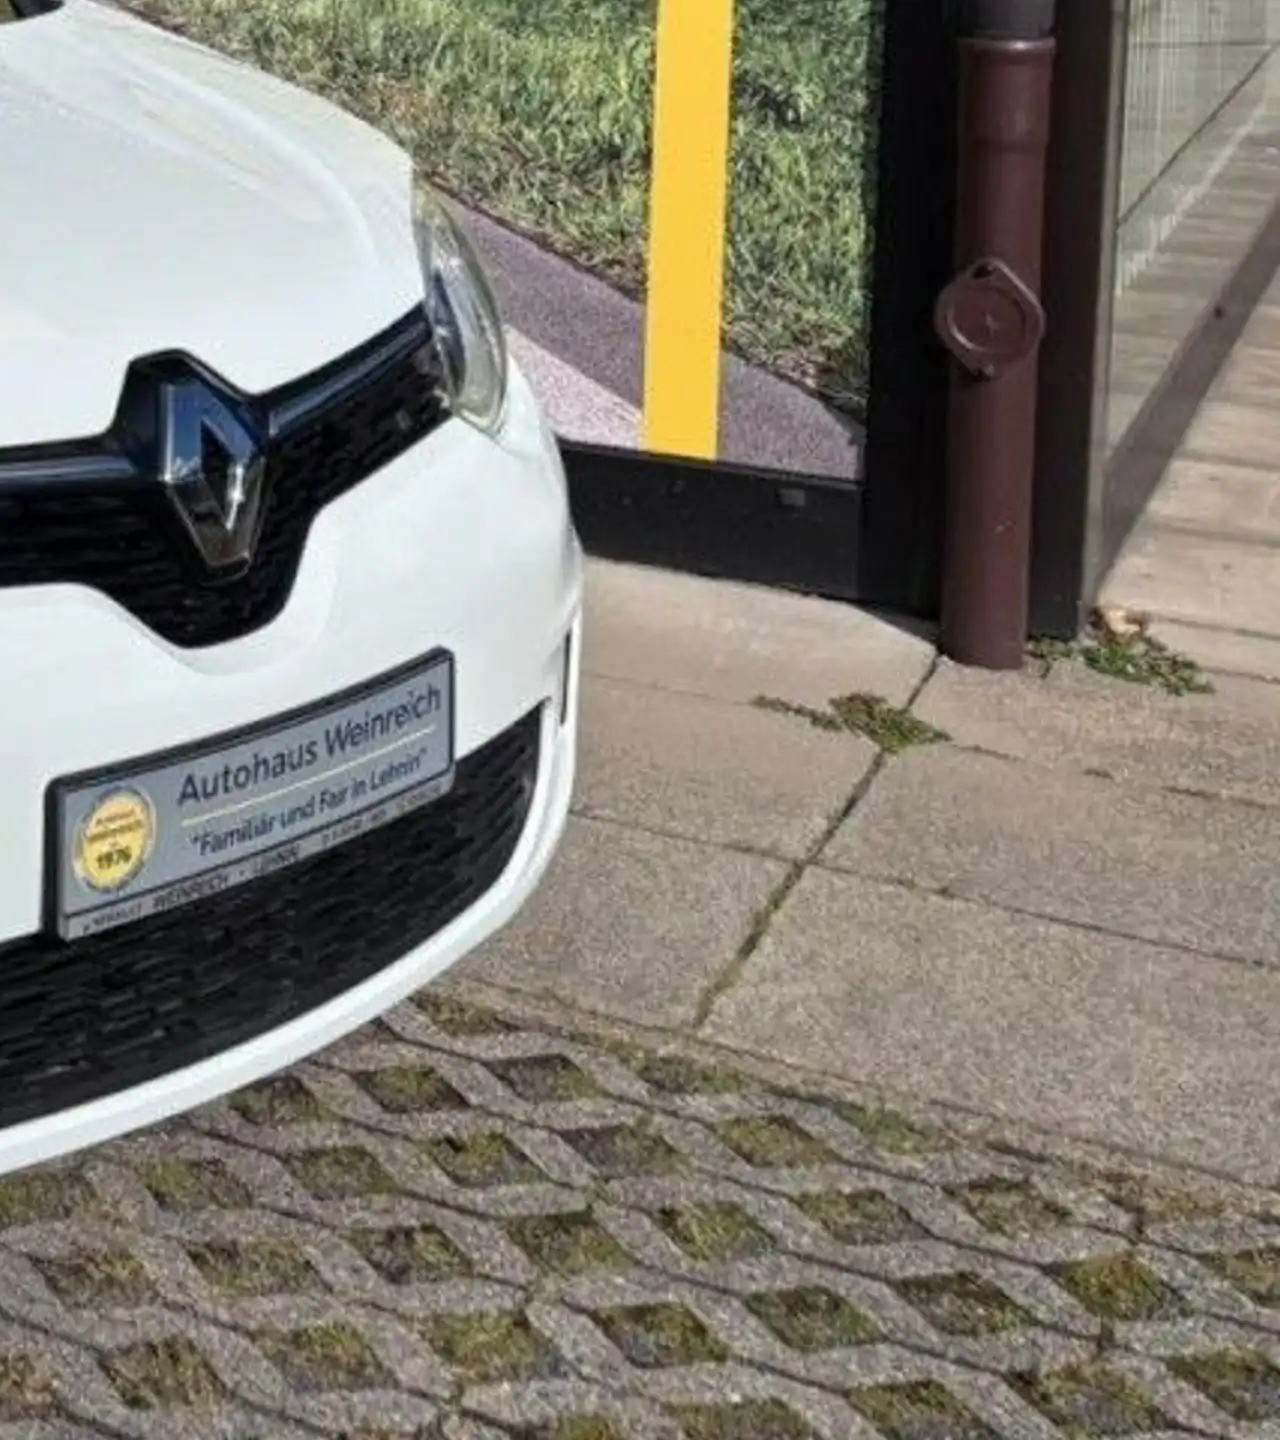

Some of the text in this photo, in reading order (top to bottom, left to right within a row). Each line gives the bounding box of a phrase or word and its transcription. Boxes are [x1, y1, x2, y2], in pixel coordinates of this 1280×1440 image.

[176, 741, 319, 806] Autohaus
[325, 682, 441, 758] Weinreich
[280, 795, 316, 830] und
